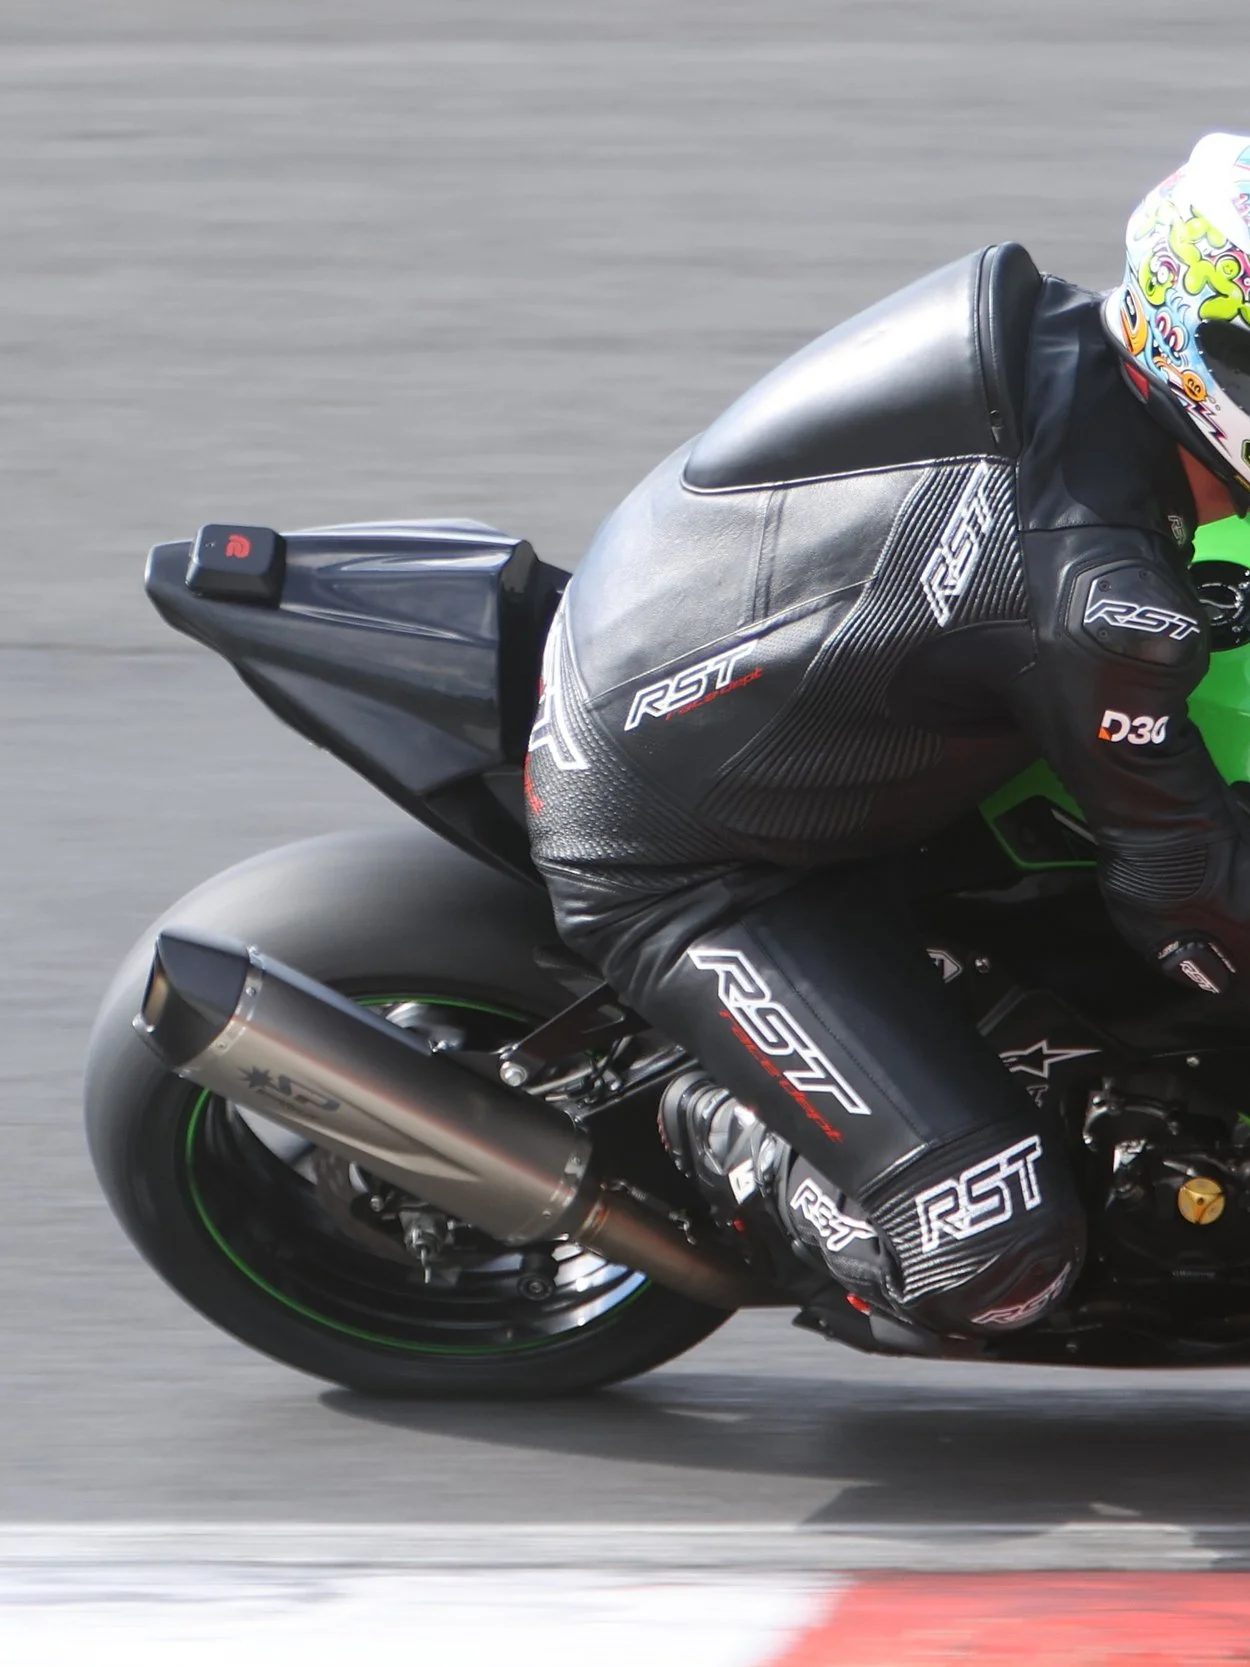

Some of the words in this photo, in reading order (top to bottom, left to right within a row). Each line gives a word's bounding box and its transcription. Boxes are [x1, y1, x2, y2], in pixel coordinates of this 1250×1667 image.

[921, 460, 994, 628] RST
[1083, 599, 1201, 641] RST
[624, 639, 758, 731] RST
[1179, 960, 1220, 994] RST
[688, 948, 871, 1115] RST
[790, 1177, 879, 1252] RST
[914, 1134, 1042, 1254] RST
